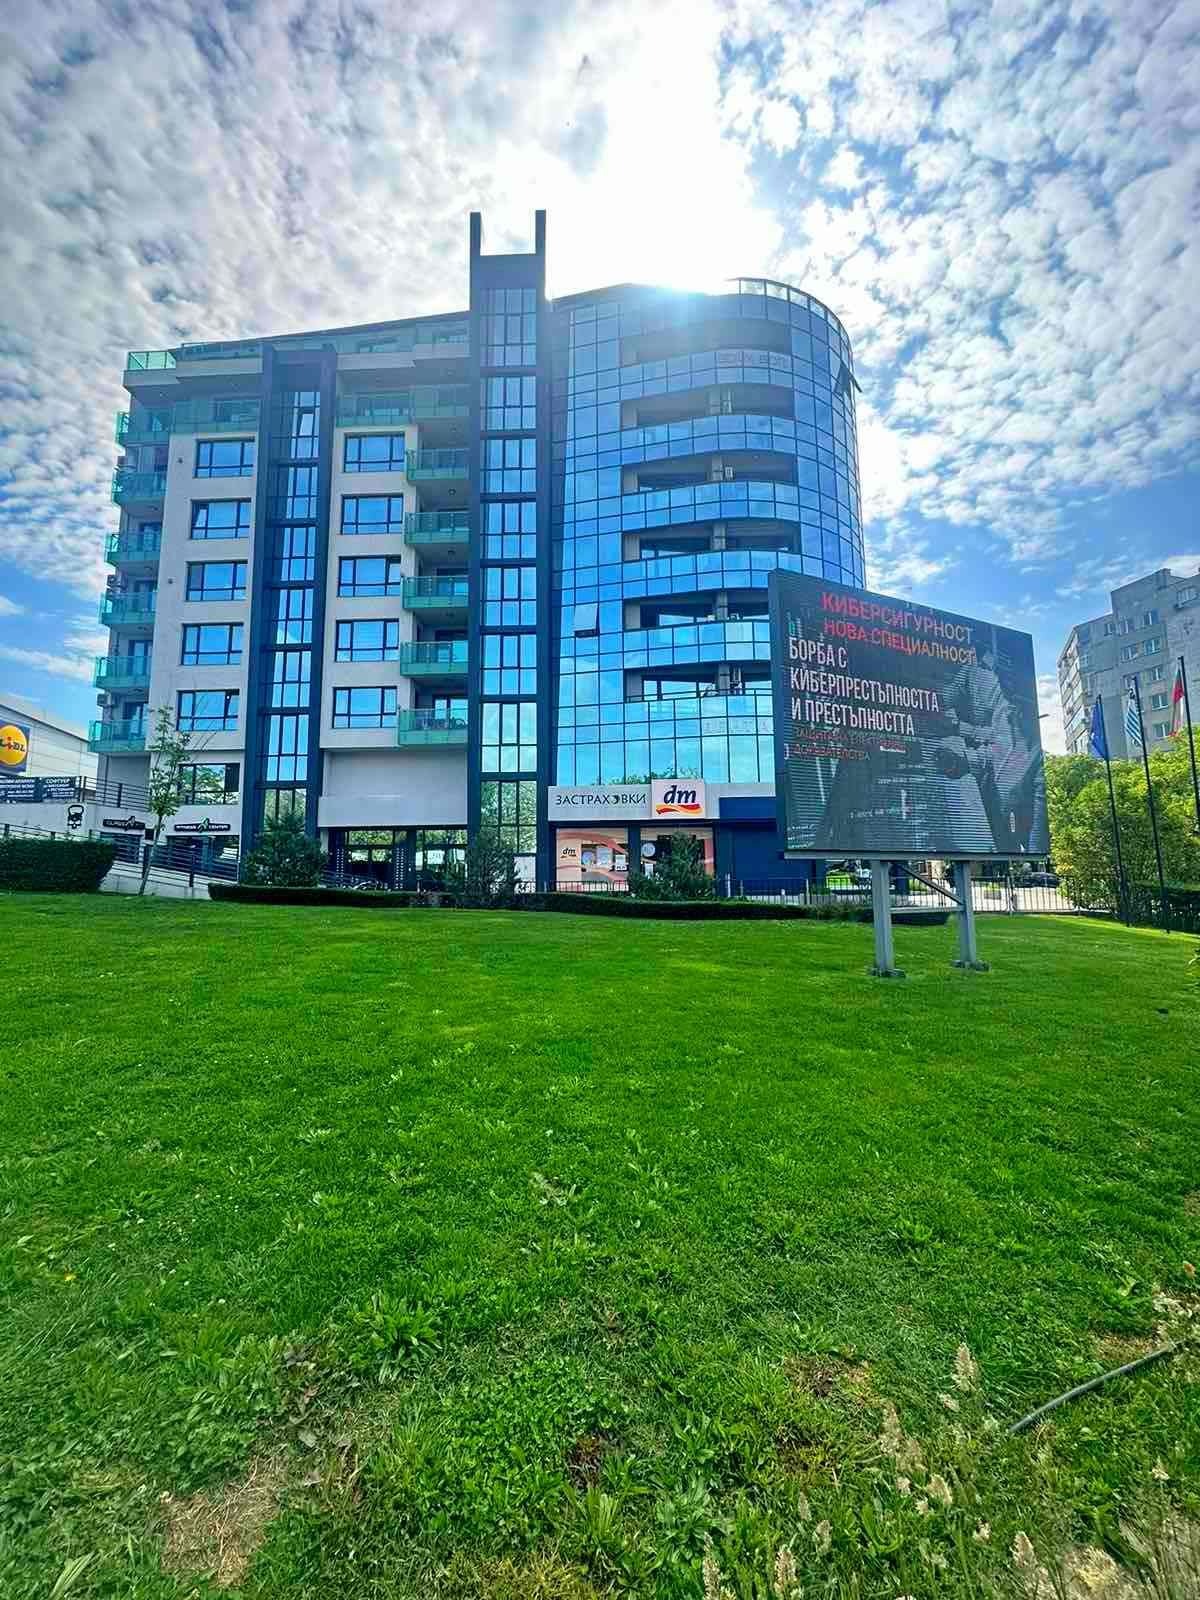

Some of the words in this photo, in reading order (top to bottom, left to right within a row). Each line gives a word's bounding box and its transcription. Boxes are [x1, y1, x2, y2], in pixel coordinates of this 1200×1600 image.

[821, 591, 974, 644] КИБЕРСИГУРНОСТ
[823, 619, 867, 642] НОВА
[788, 636, 836, 666] БОРБА
[838, 647, 848, 669] С
[789, 666, 940, 713] КИБЕРПРЕСТЪПНОСТТА
[791, 696, 802, 721] И
[805, 699, 915, 736] ПРЕСТЪПНОСТТА
[663, 785, 697, 804] dm
